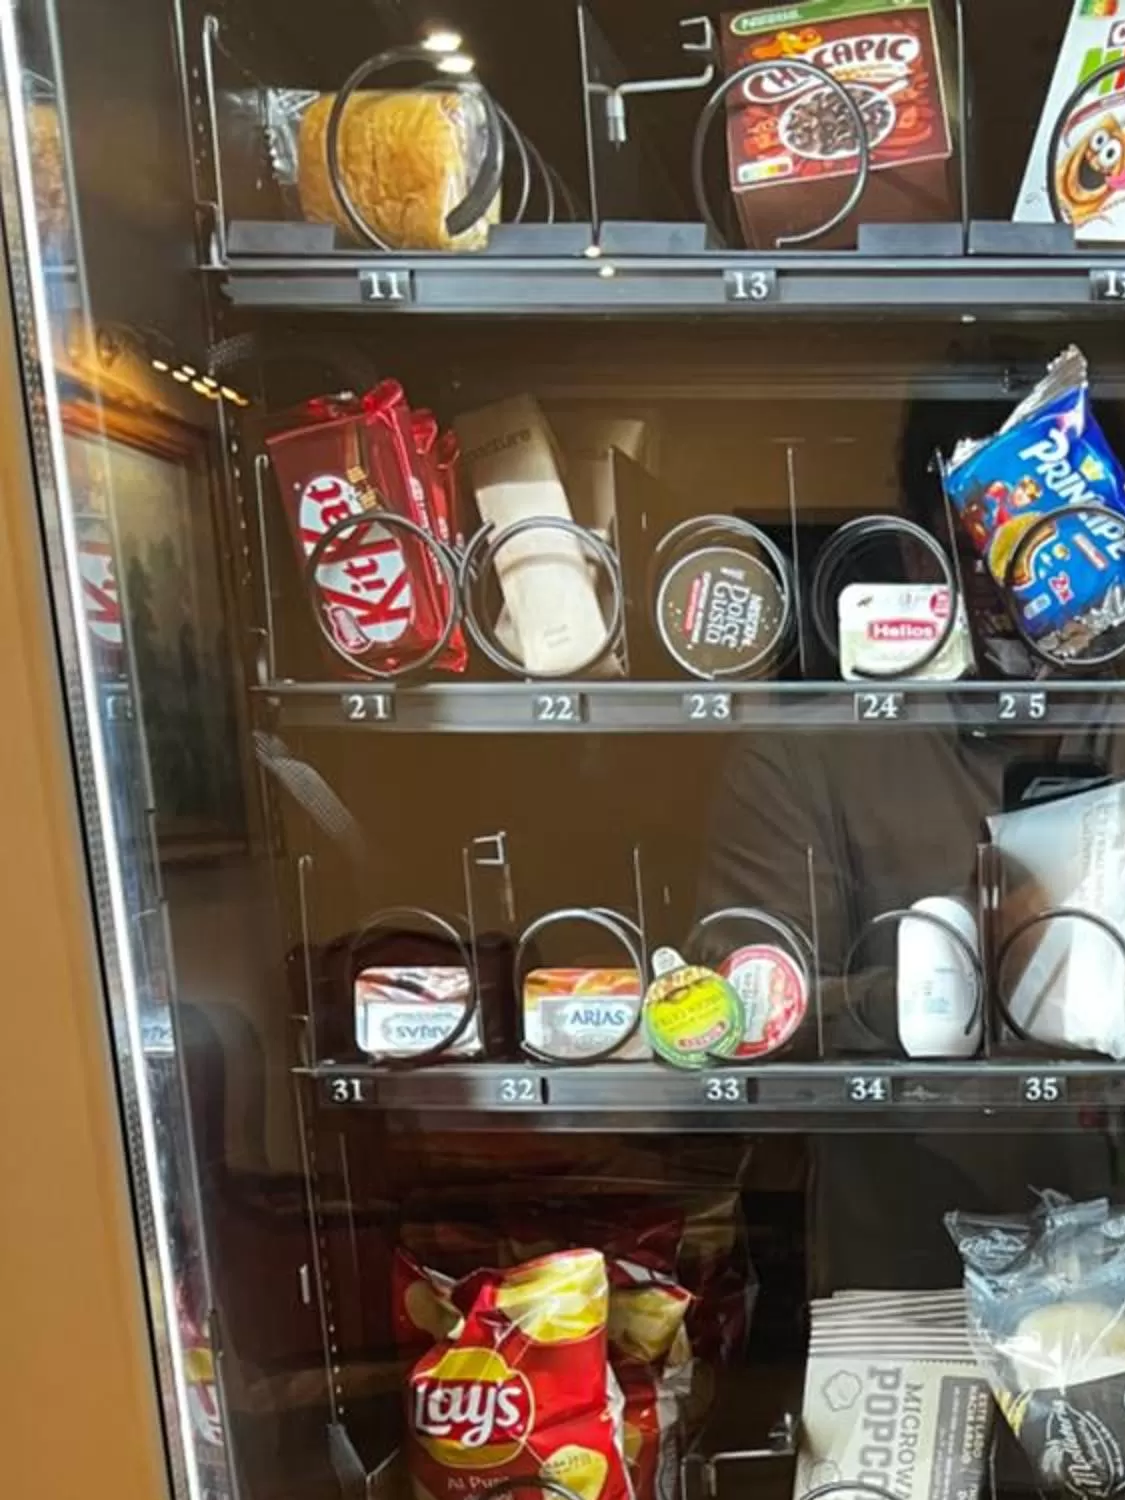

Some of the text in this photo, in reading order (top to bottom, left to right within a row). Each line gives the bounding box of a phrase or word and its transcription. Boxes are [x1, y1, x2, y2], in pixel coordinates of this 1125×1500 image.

[368, 274, 404, 300] 11
[732, 271, 769, 299] 13
[720, 583, 751, 649] Dolce
[872, 621, 936, 640] Helios
[349, 694, 389, 720] 21
[537, 695, 574, 721] 22
[689, 693, 731, 720] 23
[862, 693, 898, 720] 24
[999, 692, 1046, 719] 25
[569, 1009, 626, 1028] ARIAS
[331, 1079, 366, 1102] 31
[501, 1078, 536, 1101] 32
[706, 1077, 741, 1100] 33
[849, 1077, 886, 1100] 34
[1024, 1076, 1059, 1101] 35
[414, 1380, 523, 1448] Lay's
